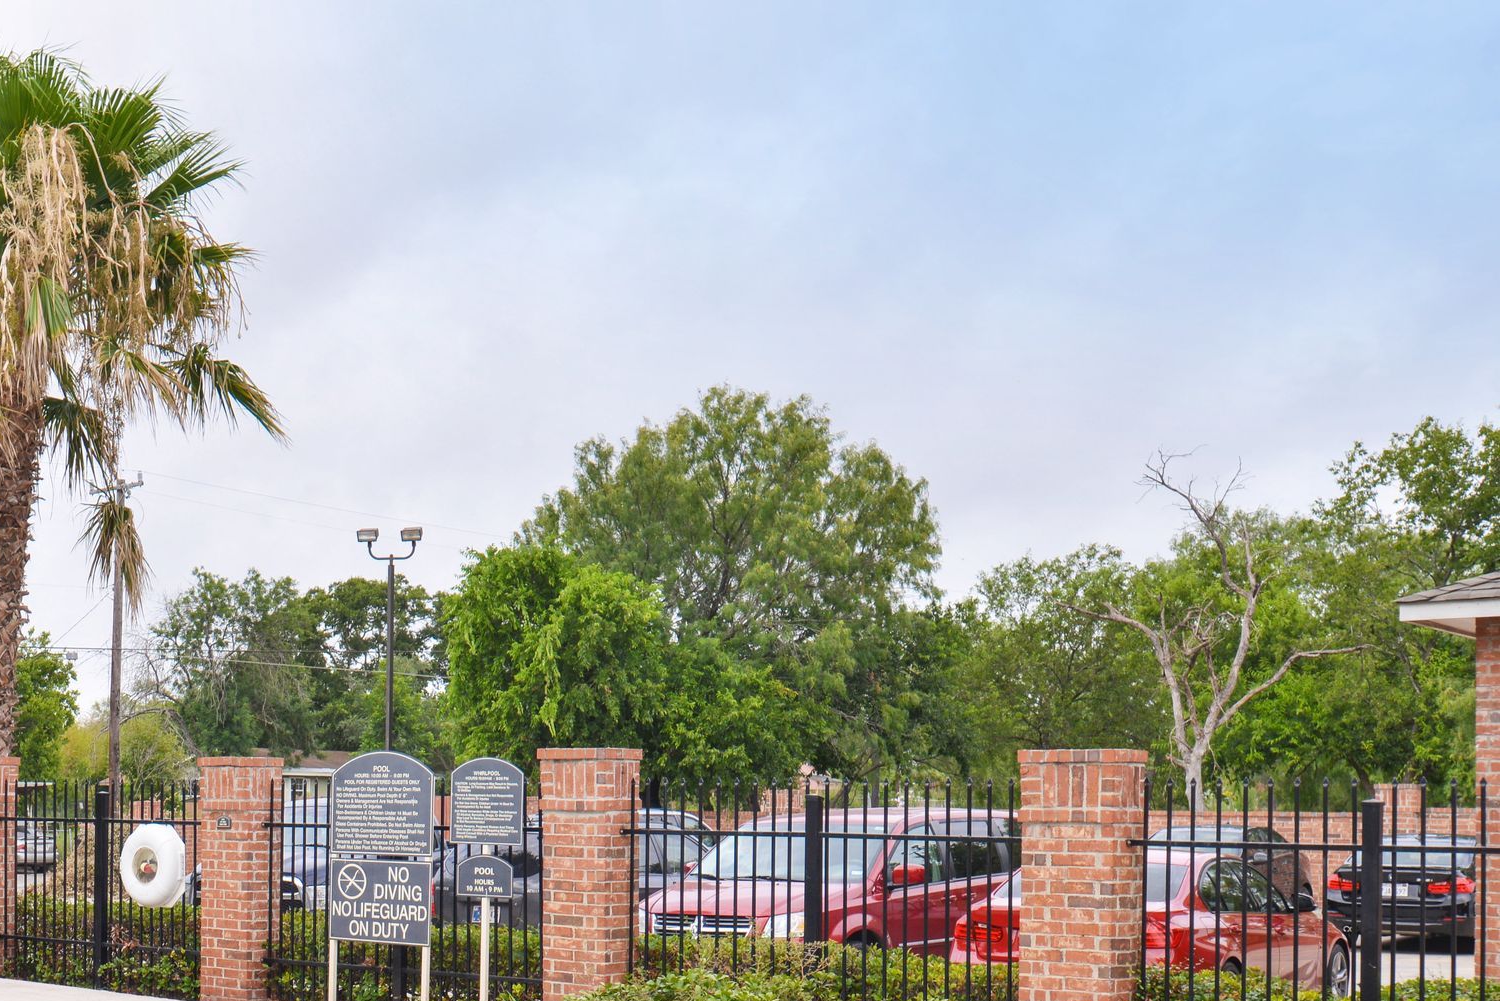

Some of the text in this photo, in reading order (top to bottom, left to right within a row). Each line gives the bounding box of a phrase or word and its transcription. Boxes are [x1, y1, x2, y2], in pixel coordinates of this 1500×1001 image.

[388, 866, 409, 883] NO
[474, 867, 494, 876] POOL
[374, 884, 422, 901] DIVING
[332, 900, 427, 921] NO LIFEGUARD
[349, 920, 409, 939] ON DUTY
